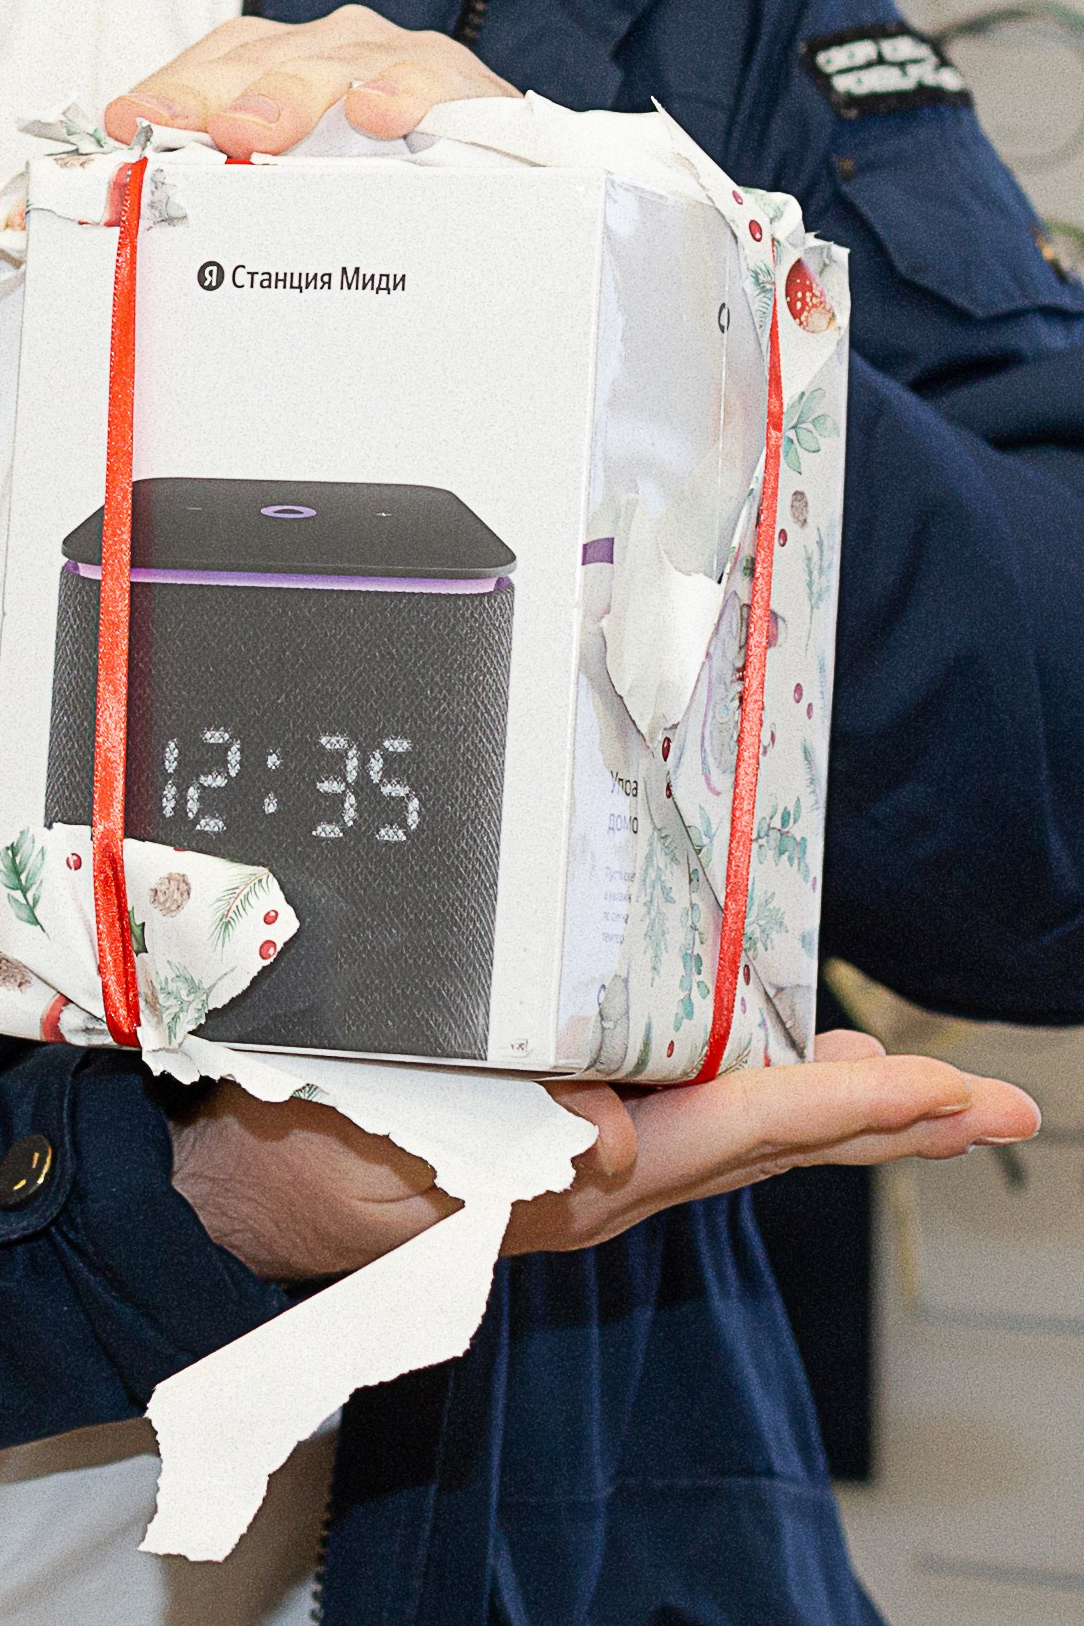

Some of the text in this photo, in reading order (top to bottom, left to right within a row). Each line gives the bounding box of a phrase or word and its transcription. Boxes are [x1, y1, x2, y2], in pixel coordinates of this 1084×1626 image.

[231, 264, 333, 294] Станция
[339, 266, 407, 295] Миди
[161, 726, 421, 842] 12:35
